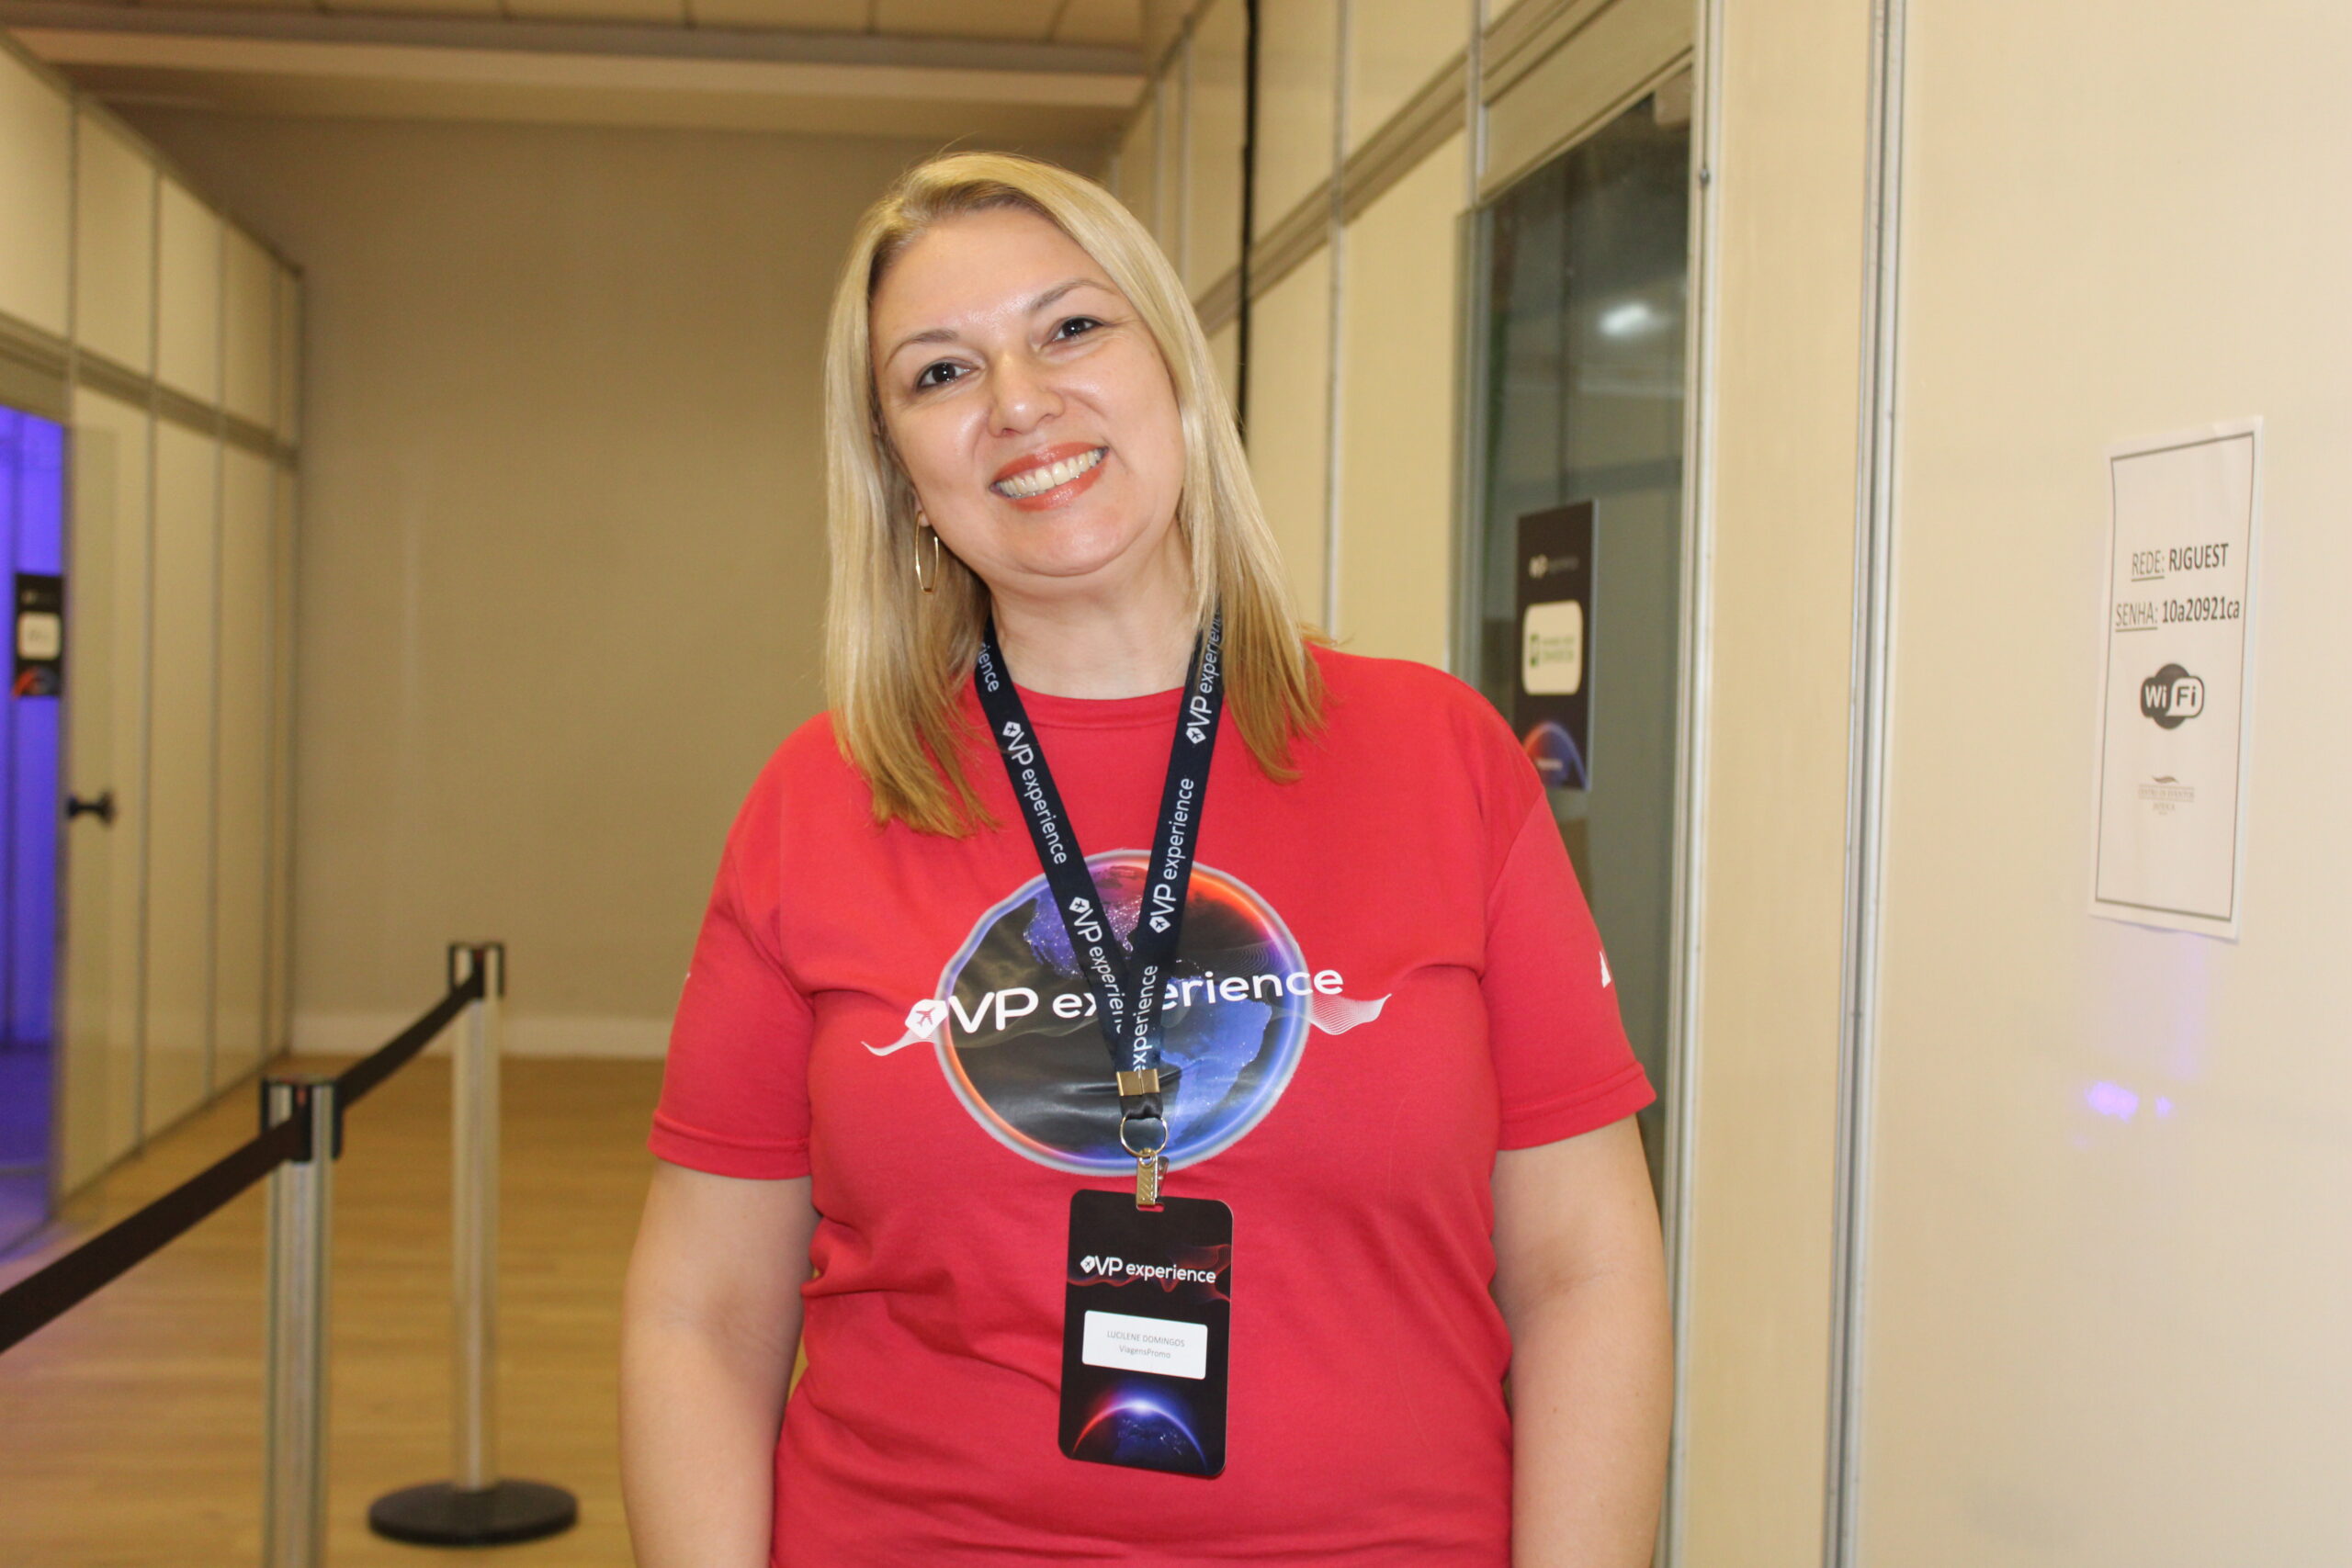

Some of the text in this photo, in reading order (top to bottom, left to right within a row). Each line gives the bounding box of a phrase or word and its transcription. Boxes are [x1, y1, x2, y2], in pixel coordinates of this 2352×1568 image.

[2132, 543, 2229, 576] REDE: RJGUEST
[2116, 596, 2240, 626] SENHA: 10a20921ca
[978, 642, 1000, 692] ience
[1186, 695, 1213, 733] VP
[1007, 729, 1068, 864] VP experience
[1150, 778, 1194, 917] VP experience
[1073, 906, 1103, 943] VP
[947, 969, 1344, 1034] VP exerience
[1093, 1255, 1216, 1283] VP experience
[1107, 1330, 1185, 1348] LUCILENE DOMINGOS
[1119, 1345, 1171, 1359] ViagensPromo
